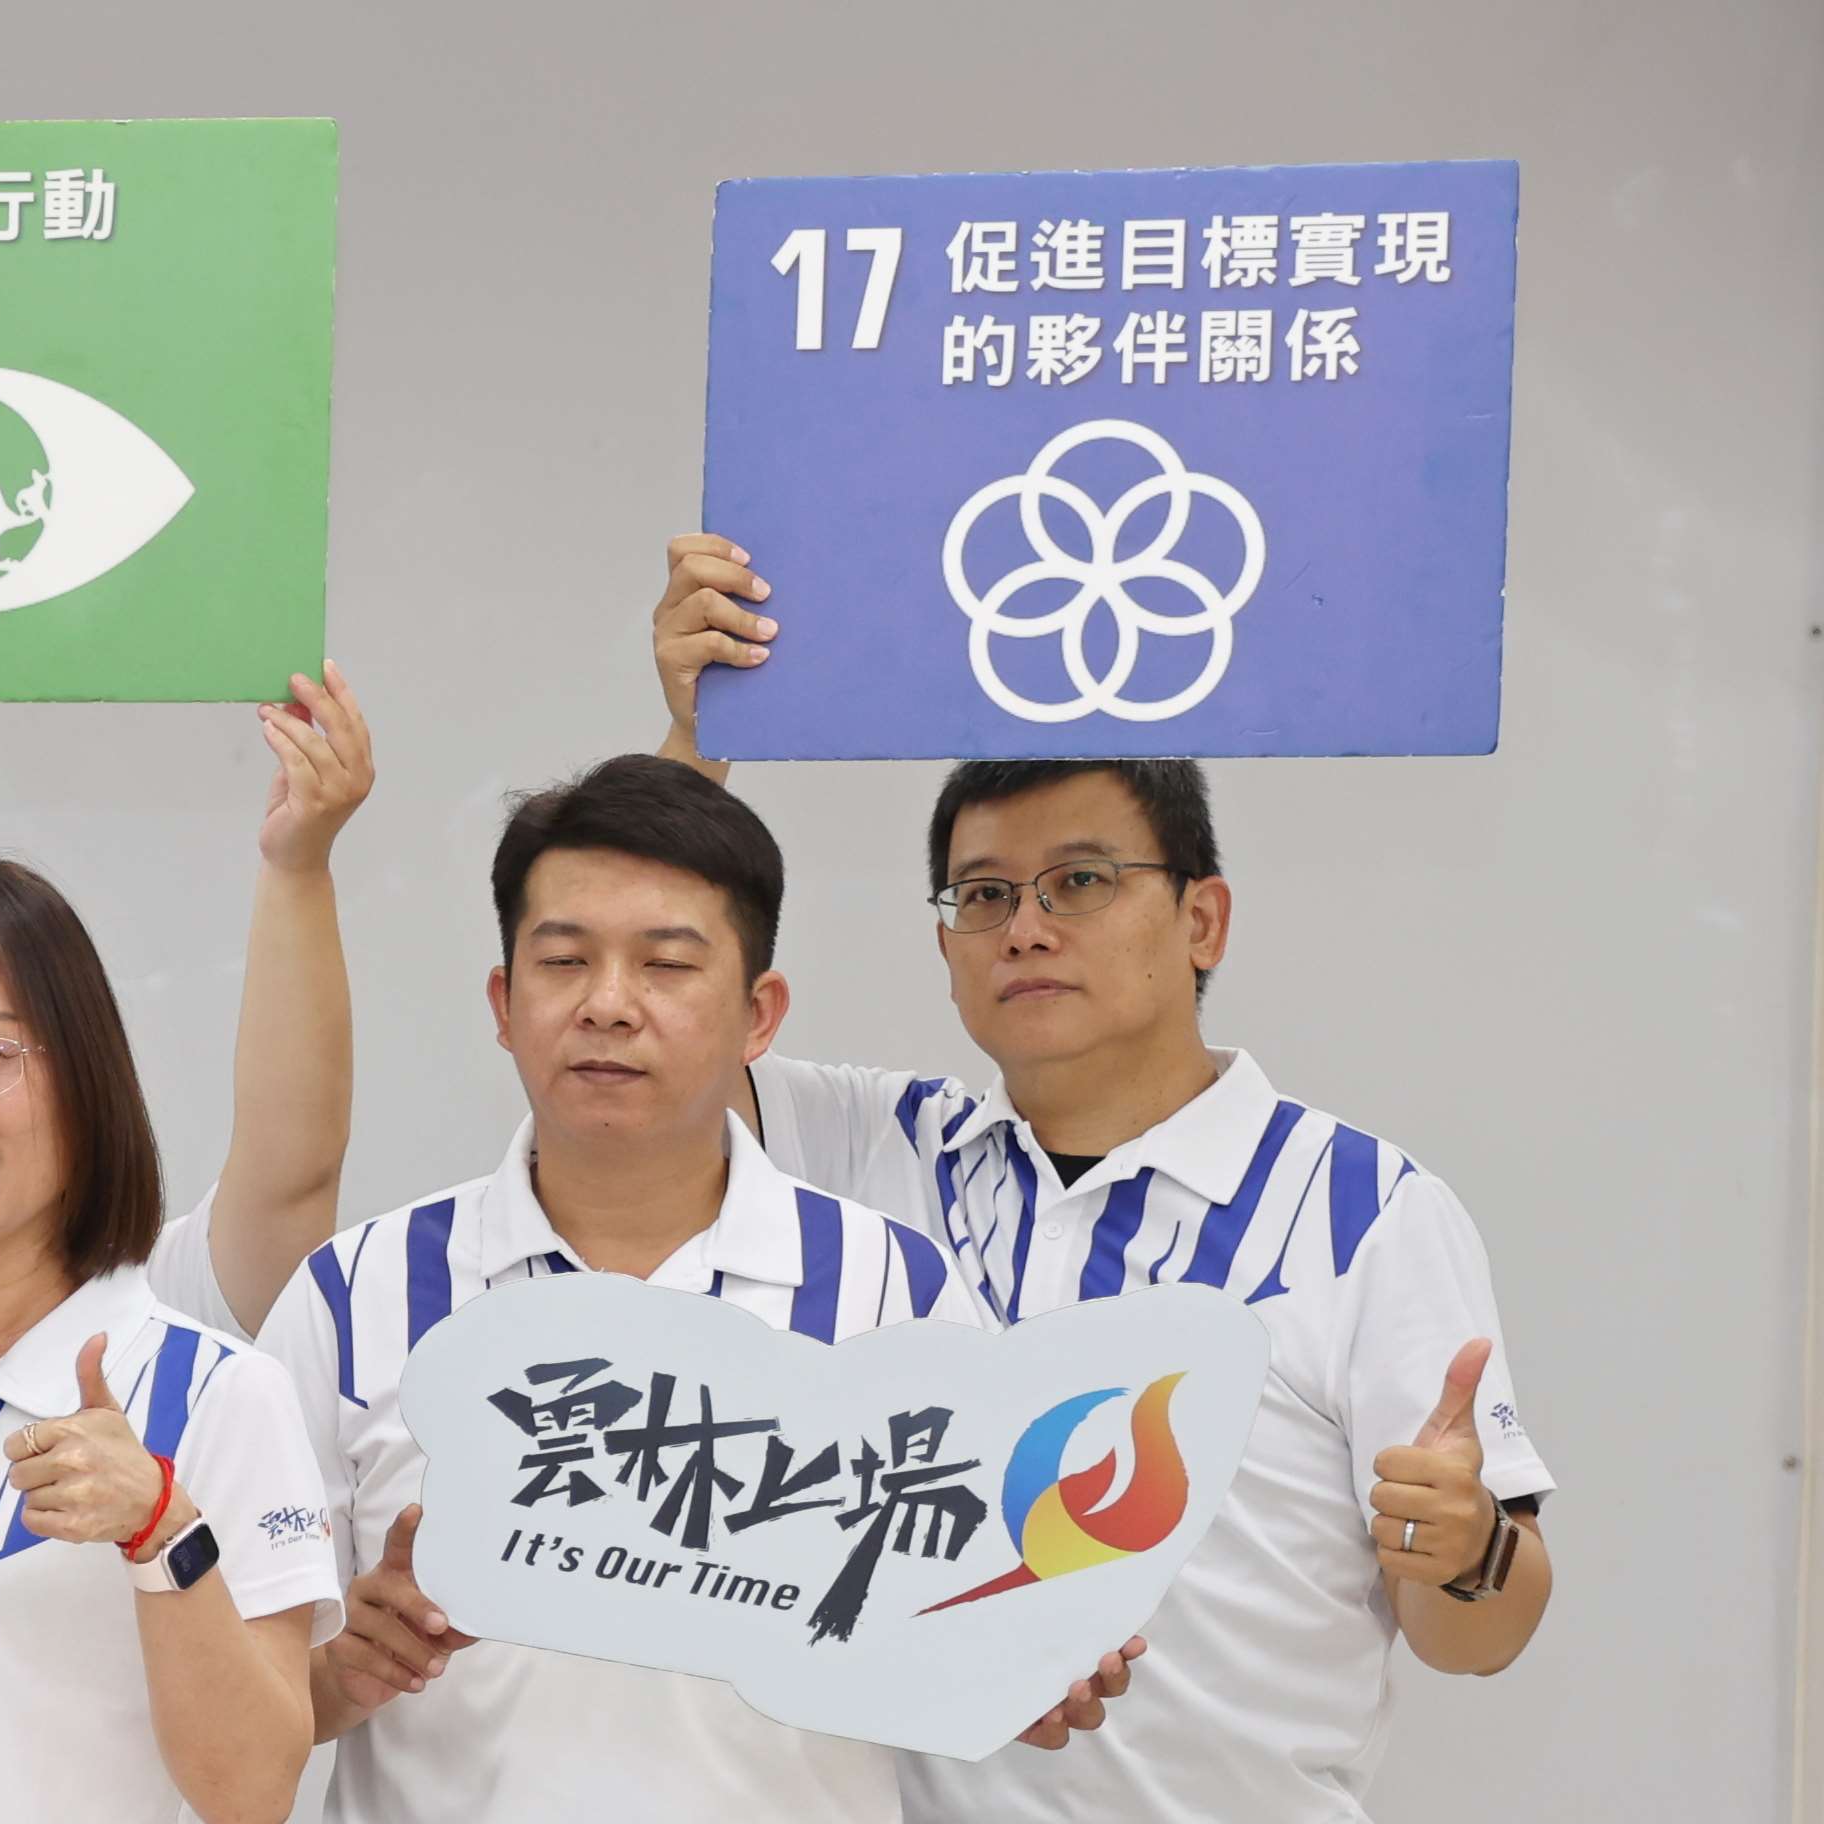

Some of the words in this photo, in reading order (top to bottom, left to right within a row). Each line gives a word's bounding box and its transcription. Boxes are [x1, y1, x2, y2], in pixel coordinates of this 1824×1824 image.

[770, 226, 903, 351] 17
[945, 210, 1452, 294] 促進目標實現
[942, 306, 1361, 387] 的夥伴關係
[487, 1358, 988, 1647] 雲林上場
[501, 1528, 585, 1574] It's
[594, 1545, 683, 1589] Our
[690, 1561, 801, 1612] Time
